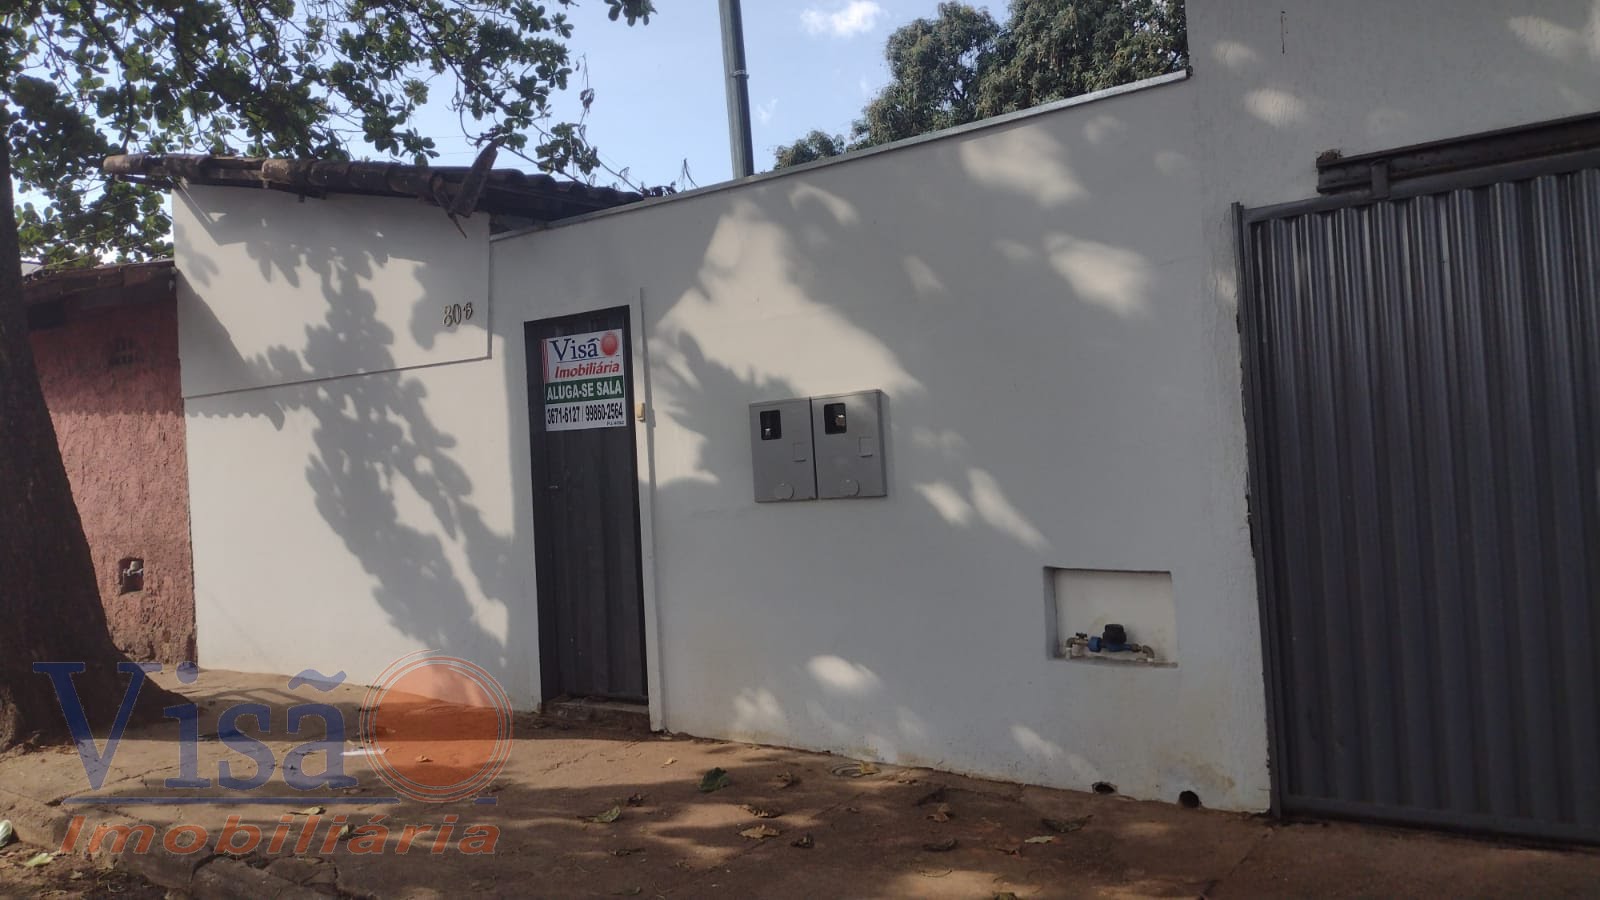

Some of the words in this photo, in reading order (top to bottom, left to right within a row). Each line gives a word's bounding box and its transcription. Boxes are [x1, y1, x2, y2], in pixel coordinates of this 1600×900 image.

[554, 361, 620, 379] Imobiliária
[547, 382, 594, 401] ALUGA-SE
[596, 379, 622, 396] SALA
[547, 405, 580, 425] 3671-6127
[585, 402, 623, 421] 99860-2564
